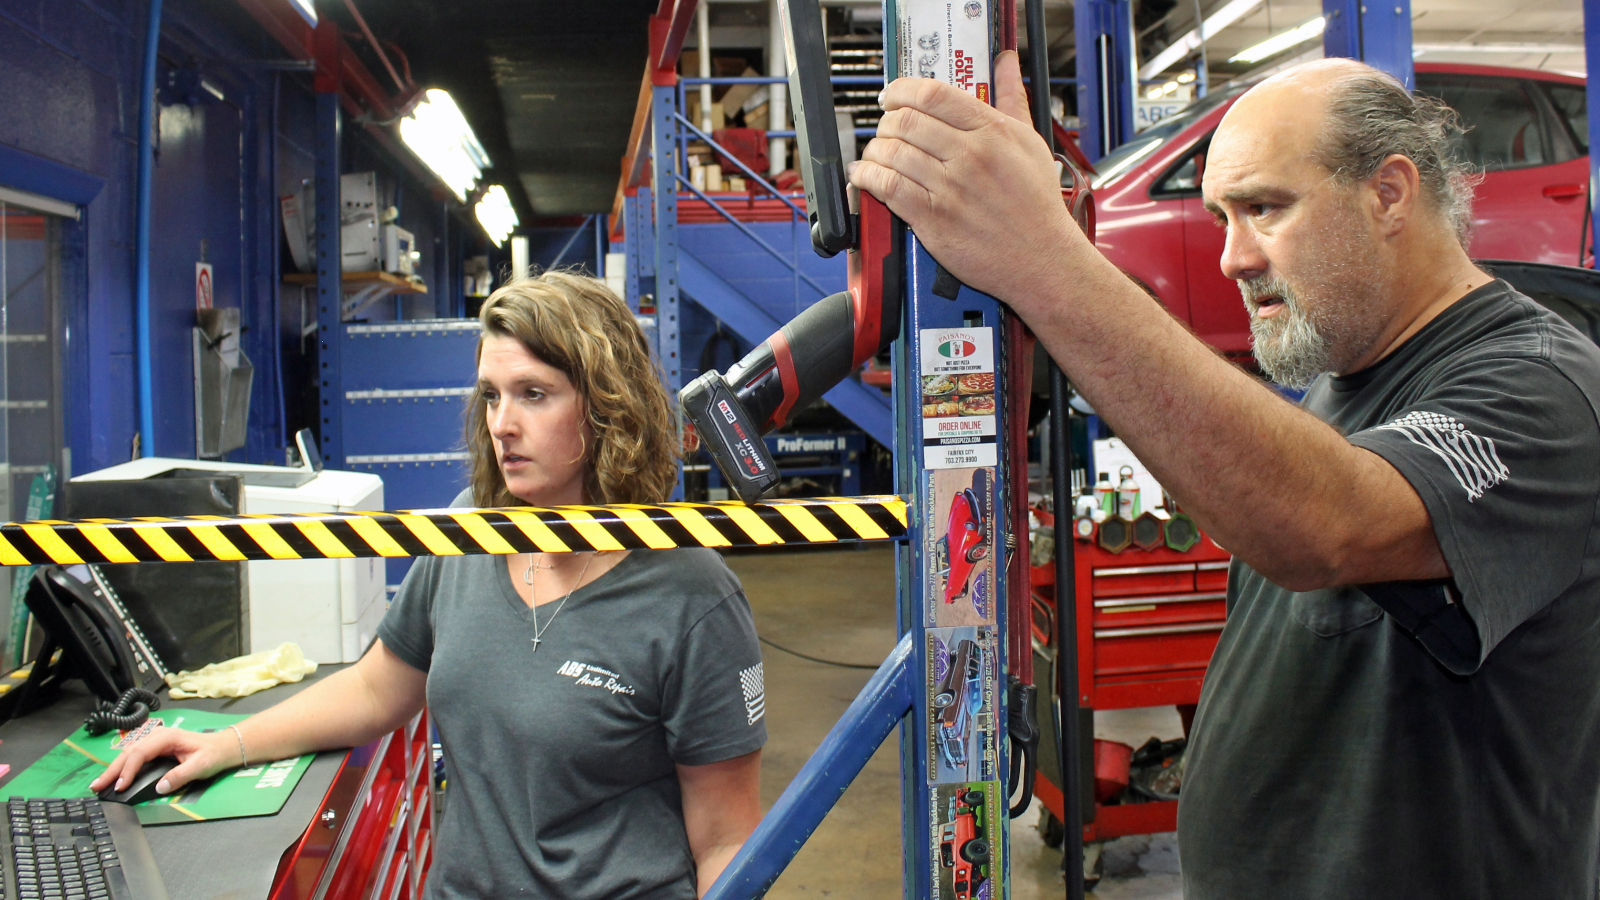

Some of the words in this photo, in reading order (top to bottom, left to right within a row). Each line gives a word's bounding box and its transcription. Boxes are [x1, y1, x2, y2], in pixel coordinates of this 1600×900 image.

[955, 50, 964, 89] BOLT-
[964, 57, 973, 90] FULL
[938, 333, 976, 343] PAISANO'S
[719, 401, 735, 421] M12
[938, 422, 959, 431] ORDER
[960, 421, 982, 430] ONLINE
[732, 422, 766, 471] REDLITHIUM
[777, 438, 835, 452] ProFormer
[556, 660, 587, 678] ABS
[586, 664, 620, 680] Unlimited
[575, 673, 603, 687] Auto
[603, 677, 636, 696] Repair
